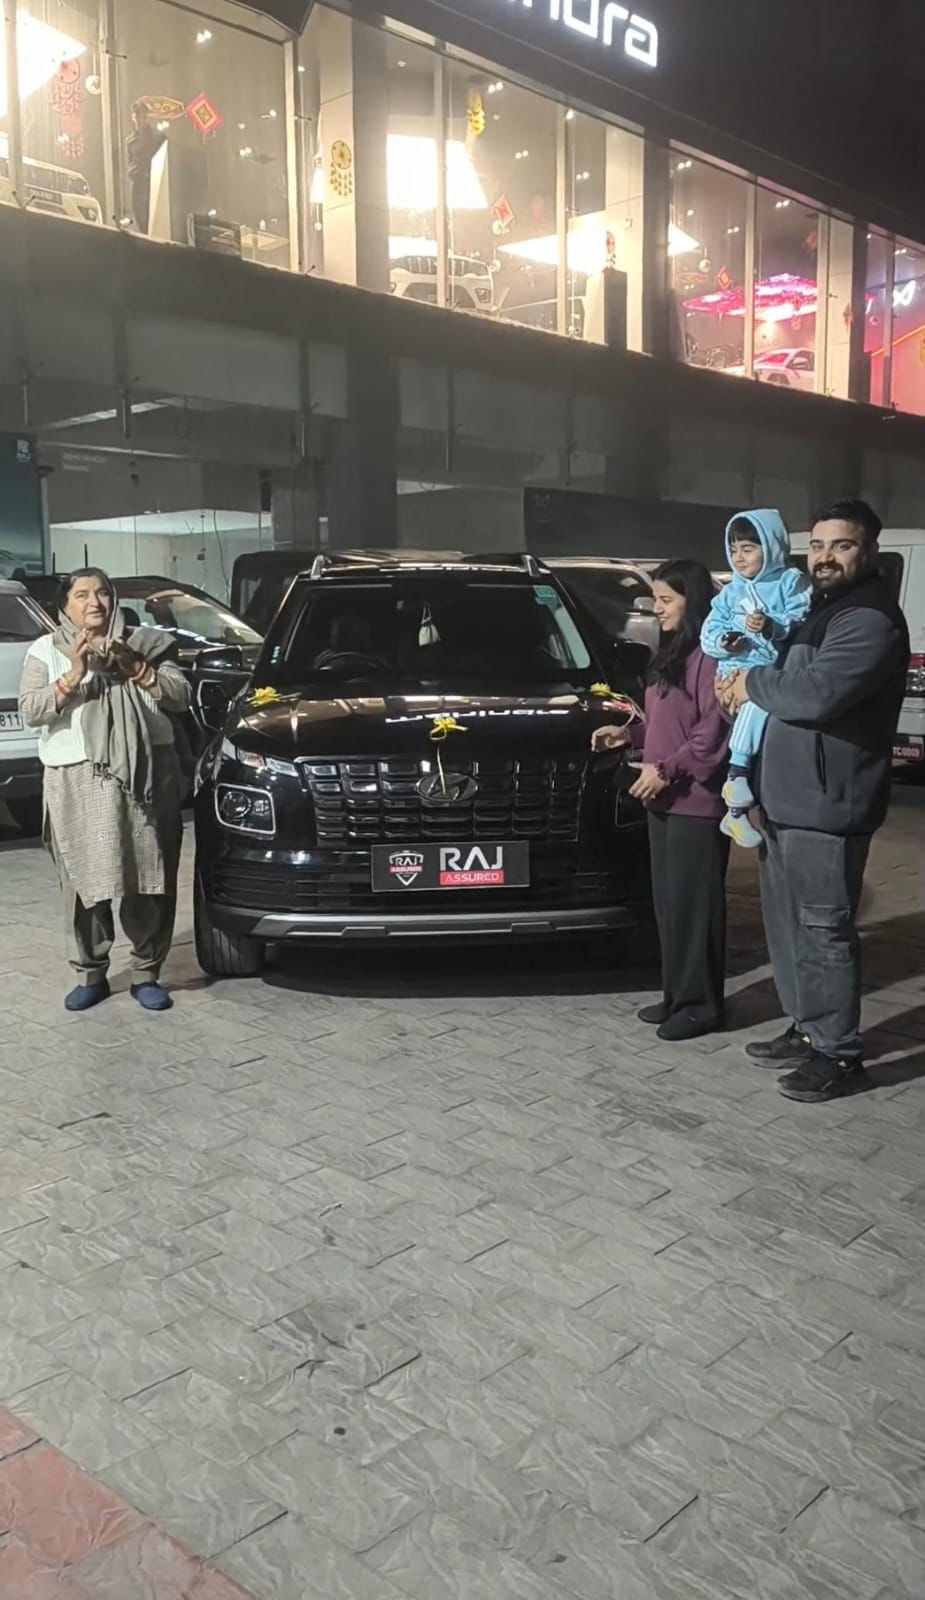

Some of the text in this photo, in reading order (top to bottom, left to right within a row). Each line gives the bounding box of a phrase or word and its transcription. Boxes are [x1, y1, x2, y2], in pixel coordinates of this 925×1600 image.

[395, 856, 418, 866] RAJ
[439, 846, 504, 871] RAJ
[445, 872, 500, 882] ASSURED
